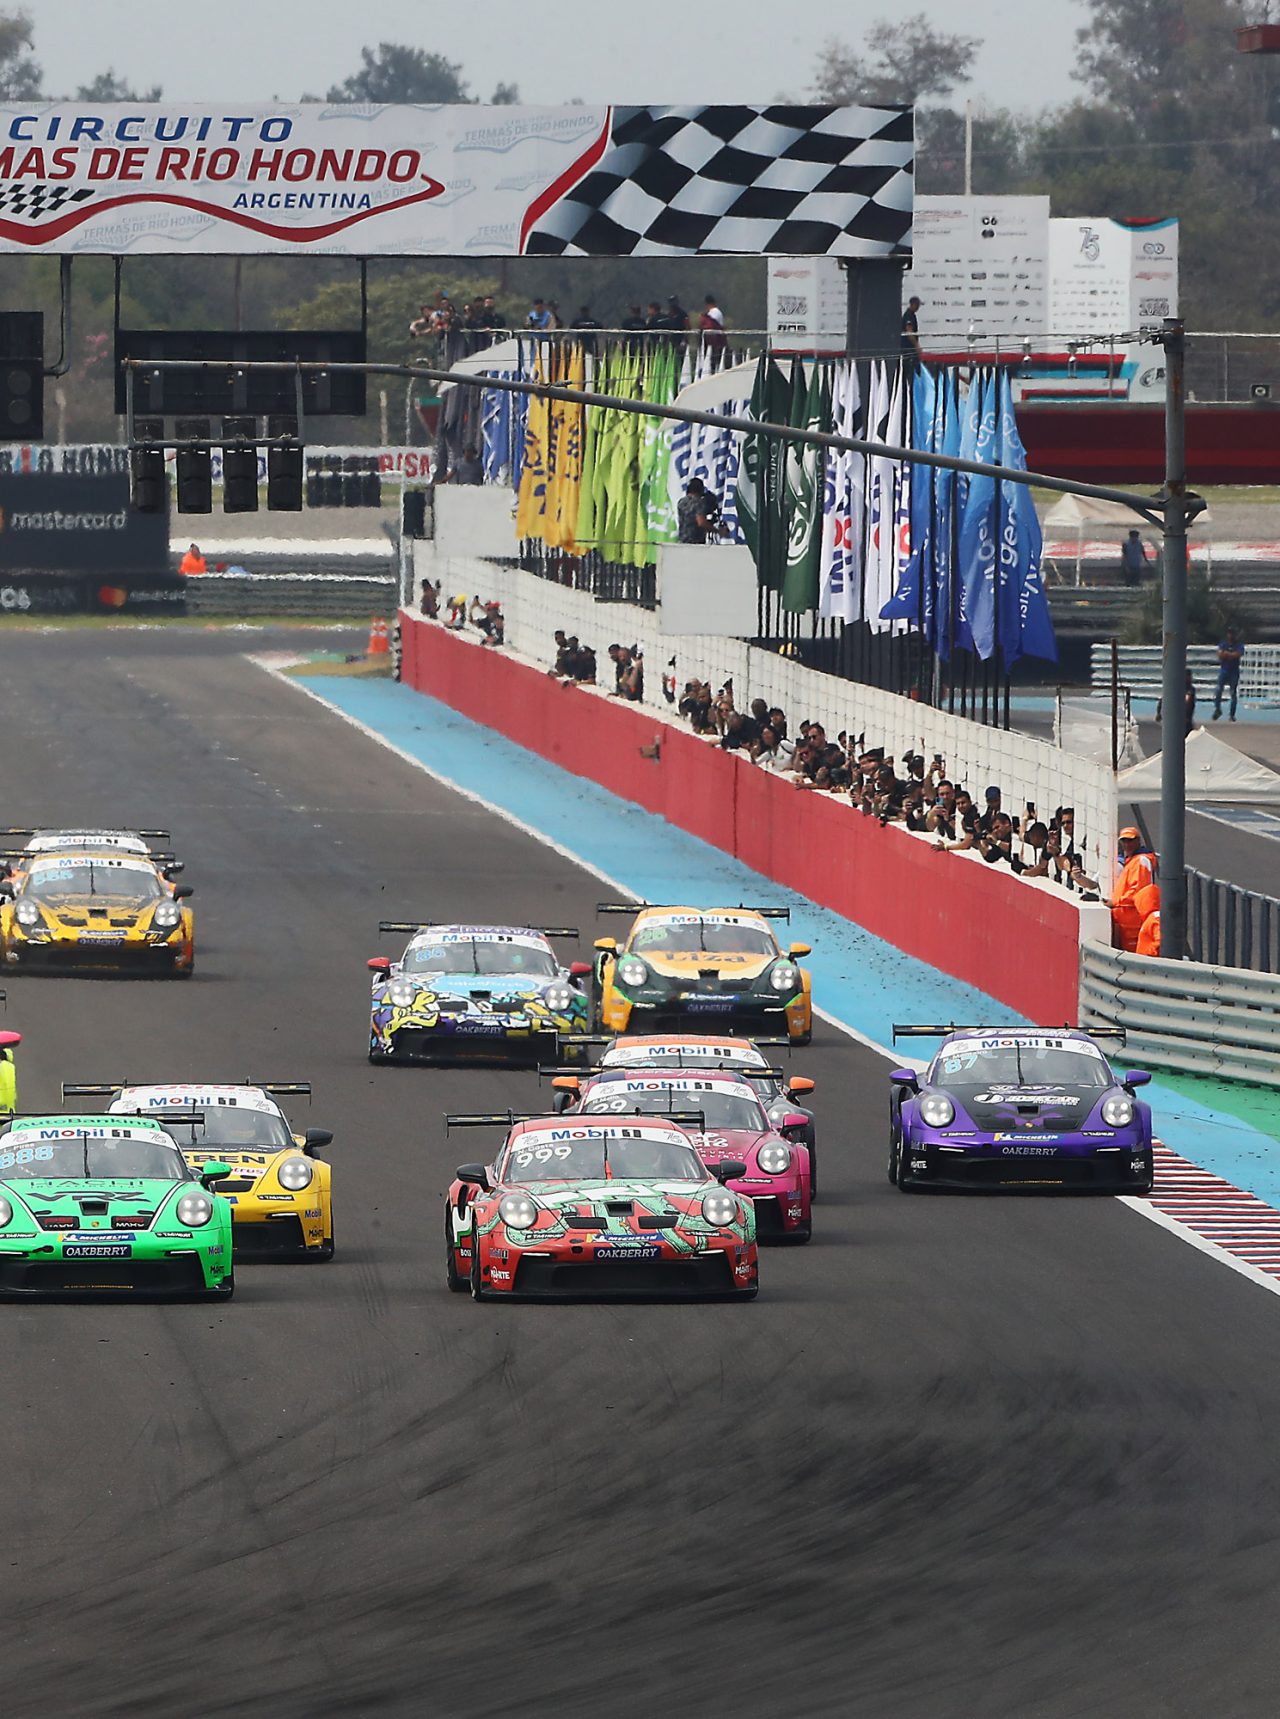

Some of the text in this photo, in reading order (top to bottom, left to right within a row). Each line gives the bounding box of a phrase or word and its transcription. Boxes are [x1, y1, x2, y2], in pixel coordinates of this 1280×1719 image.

[9, 116, 294, 142] CIRCUITO
[87, 147, 149, 181] DE
[248, 149, 421, 183] HONDO
[233, 193, 371, 209] ARGENTINA
[10, 510, 128, 532] mastercard
[981, 1040, 1039, 1049] Mobil
[648, 1046, 707, 1056] Mobil
[944, 1054, 979, 1074] 87
[627, 1081, 688, 1091] Mobil
[149, 1096, 211, 1107] Mobil
[592, 1099, 628, 1114] 29
[16, 1117, 156, 1130] AutoBanking
[39, 1129, 104, 1139] Mobil
[551, 1129, 616, 1141] Mobil
[1001, 1147, 1058, 1156] OAKBERRY
[516, 1146, 573, 1169] 999
[608, 1234, 660, 1242] MICHELIN
[66, 1246, 129, 1257] OAKBERRY
[597, 1248, 658, 1259] OAKBERRY
